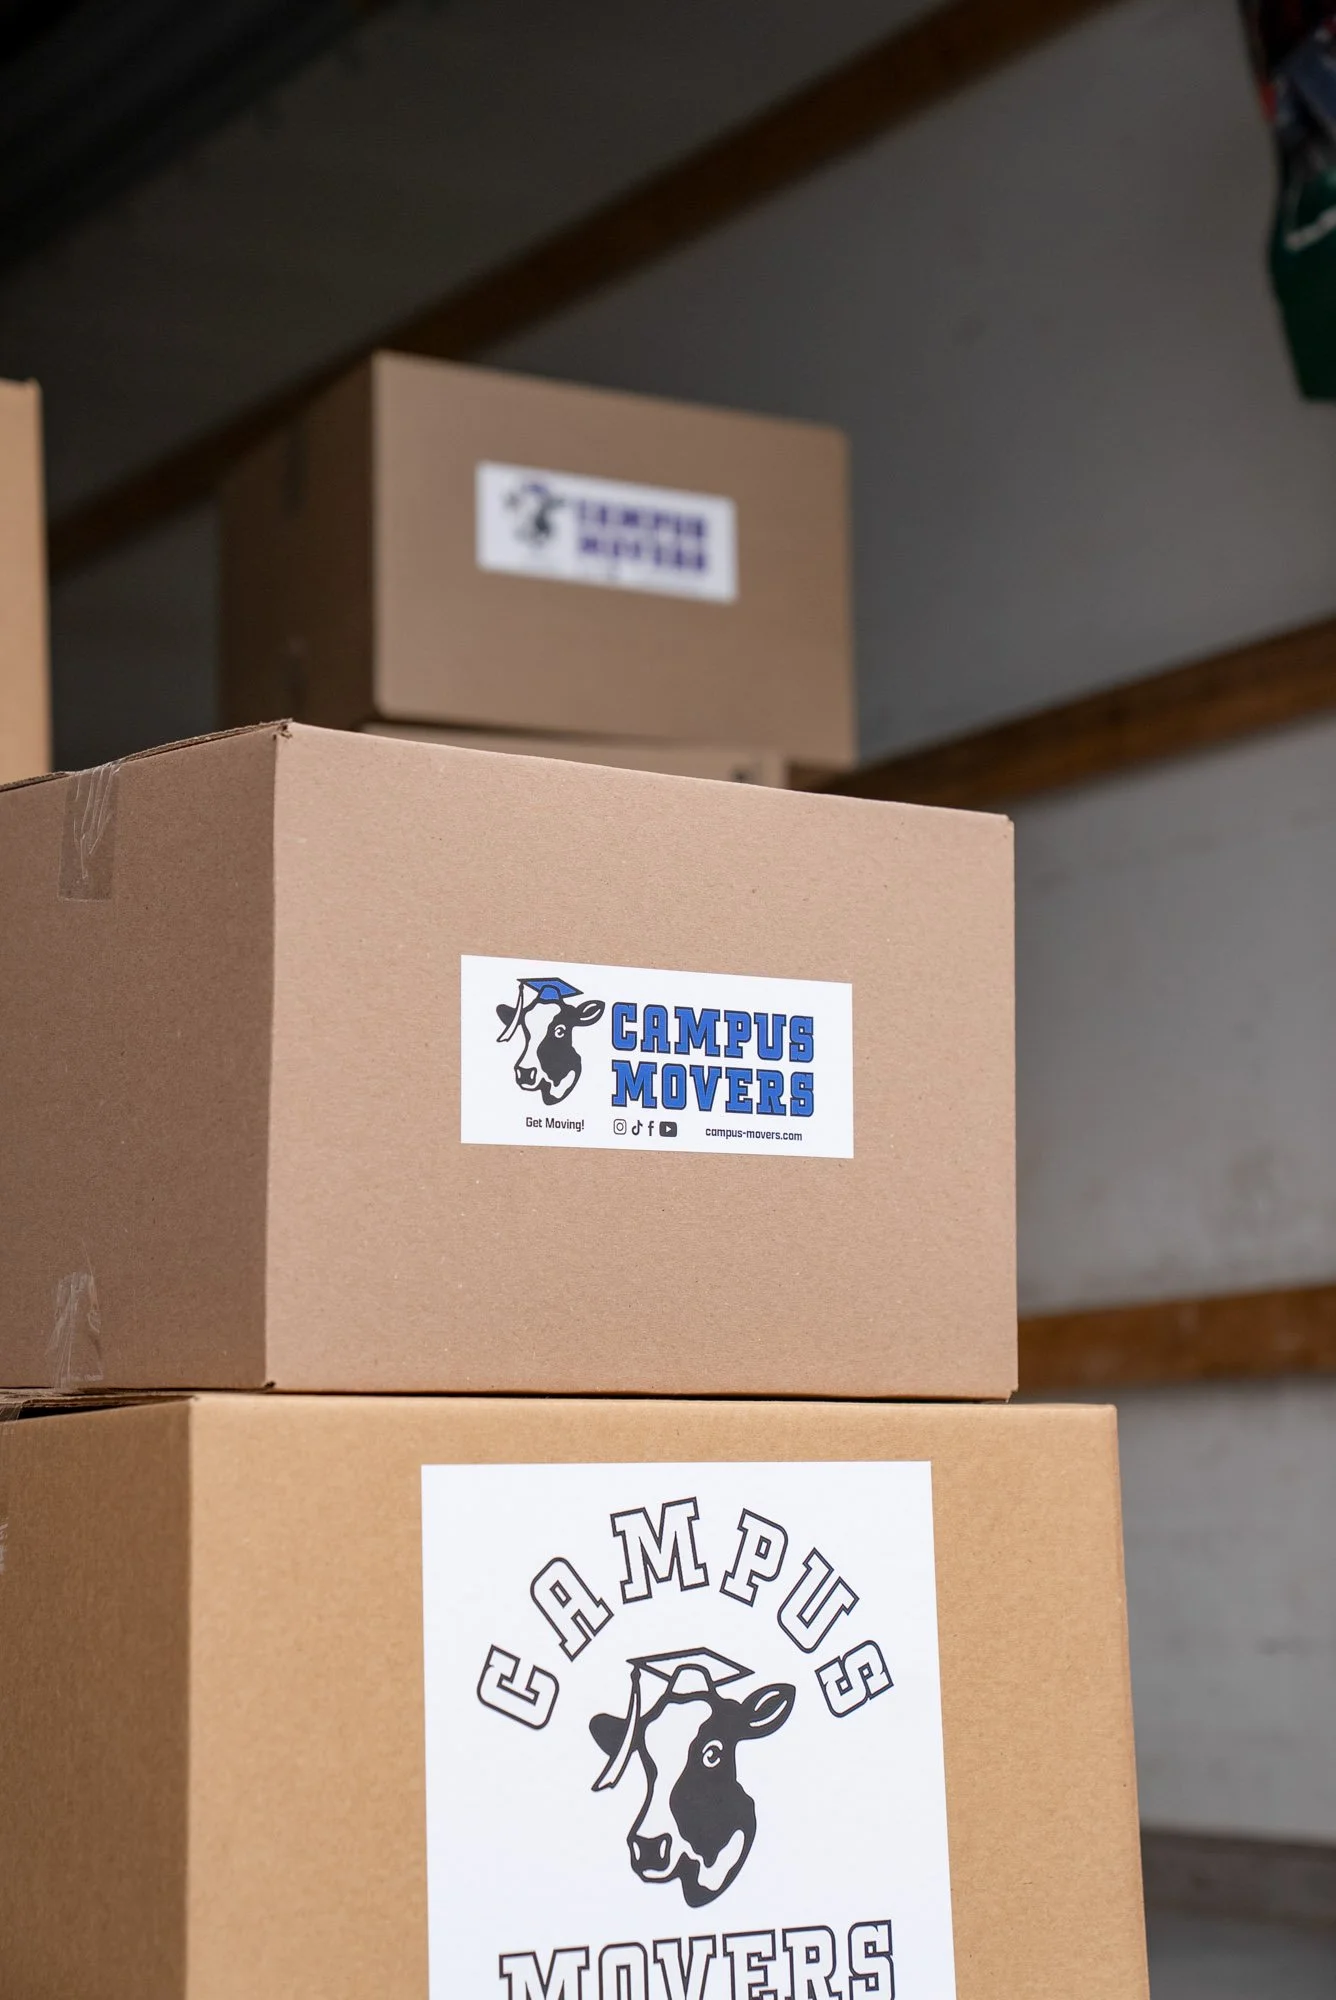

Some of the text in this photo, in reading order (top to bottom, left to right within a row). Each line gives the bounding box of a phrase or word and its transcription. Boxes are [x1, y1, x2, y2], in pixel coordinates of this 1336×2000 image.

[611, 1001, 814, 1063] CAMPUS
[611, 1059, 814, 1117] MOVERS
[525, 1116, 585, 1132] Get Moving!
[705, 1126, 803, 1141] campus-movers.com
[477, 1496, 894, 1730] CAMPUS
